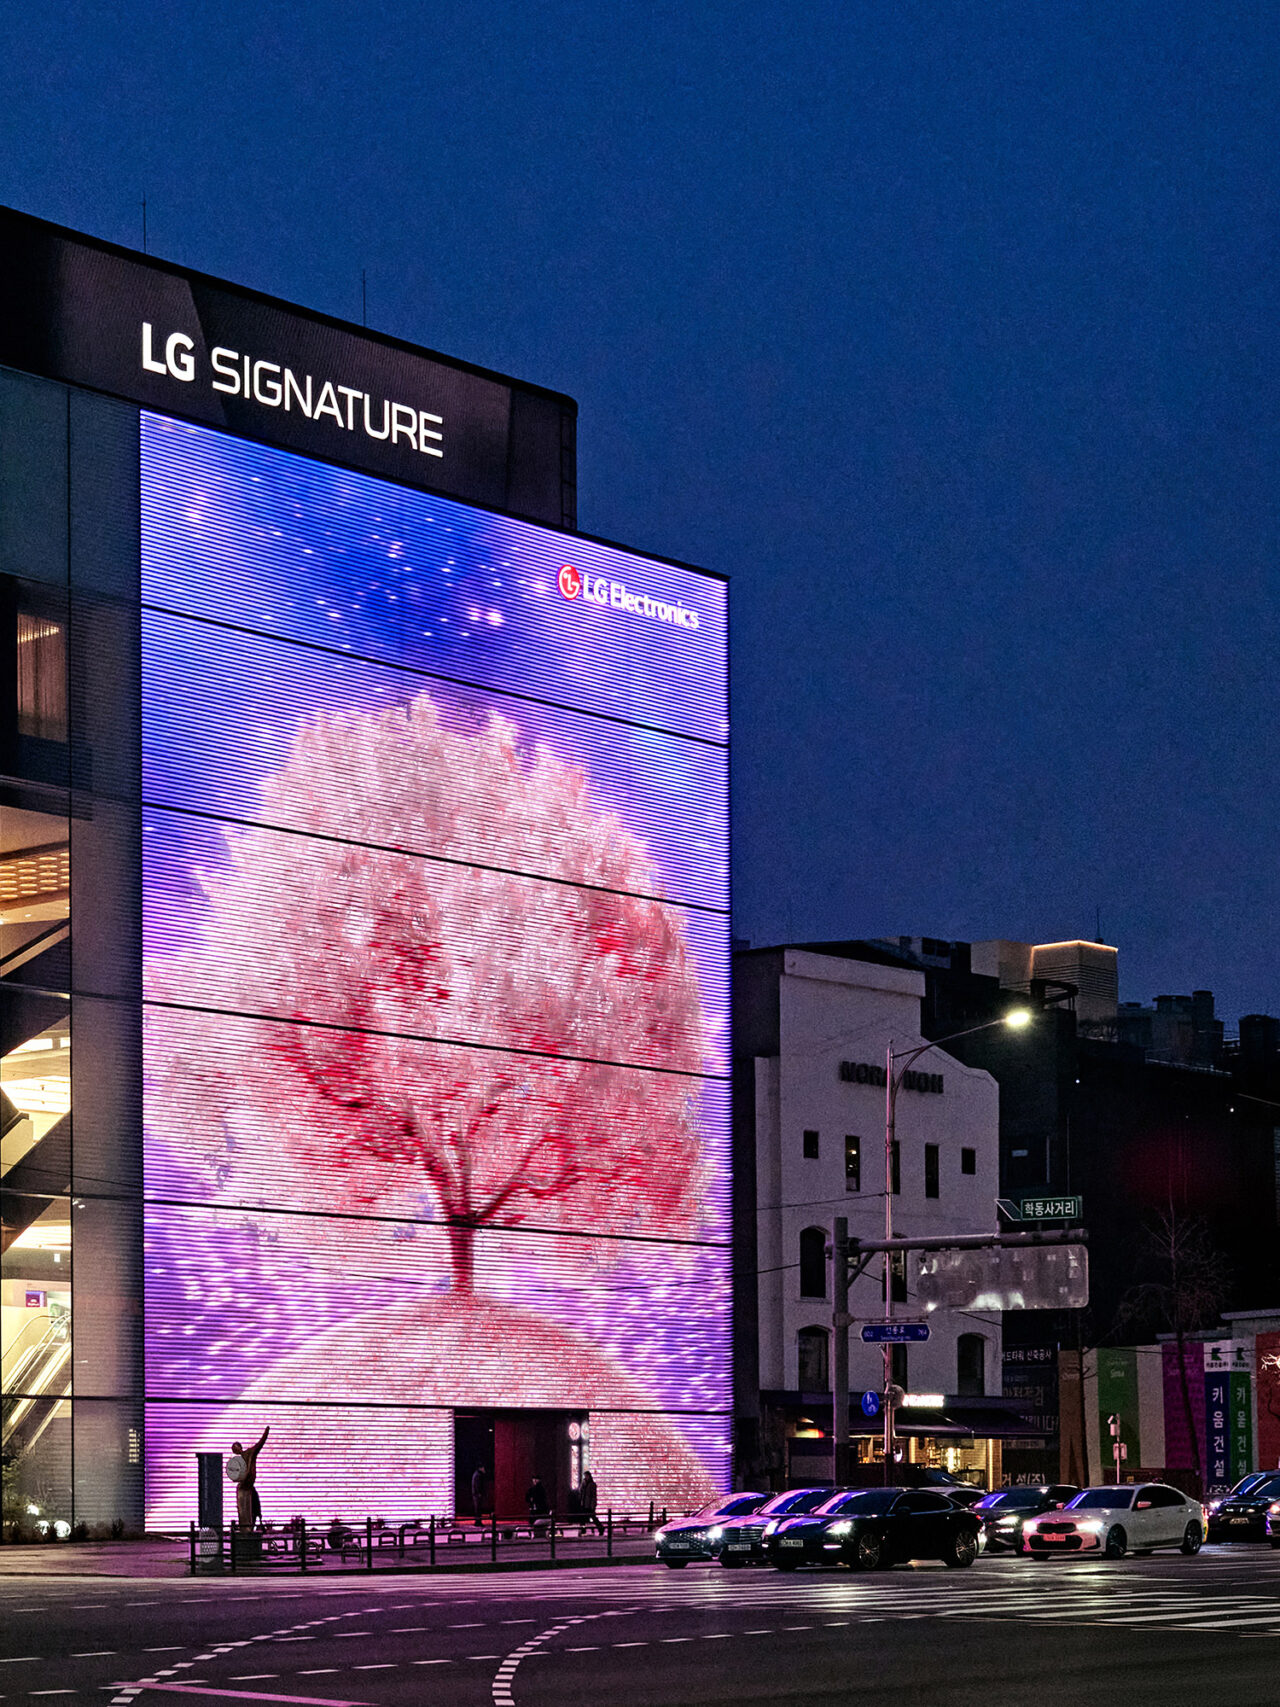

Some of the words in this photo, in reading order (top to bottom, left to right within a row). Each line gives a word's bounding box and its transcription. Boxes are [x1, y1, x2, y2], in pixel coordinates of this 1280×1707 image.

[142, 321, 196, 382] LG
[211, 346, 444, 458] SIGNATURE
[582, 574, 609, 605] LG
[610, 581, 700, 629] Electronics
[1024, 1200, 1075, 1217] 학동사거리
